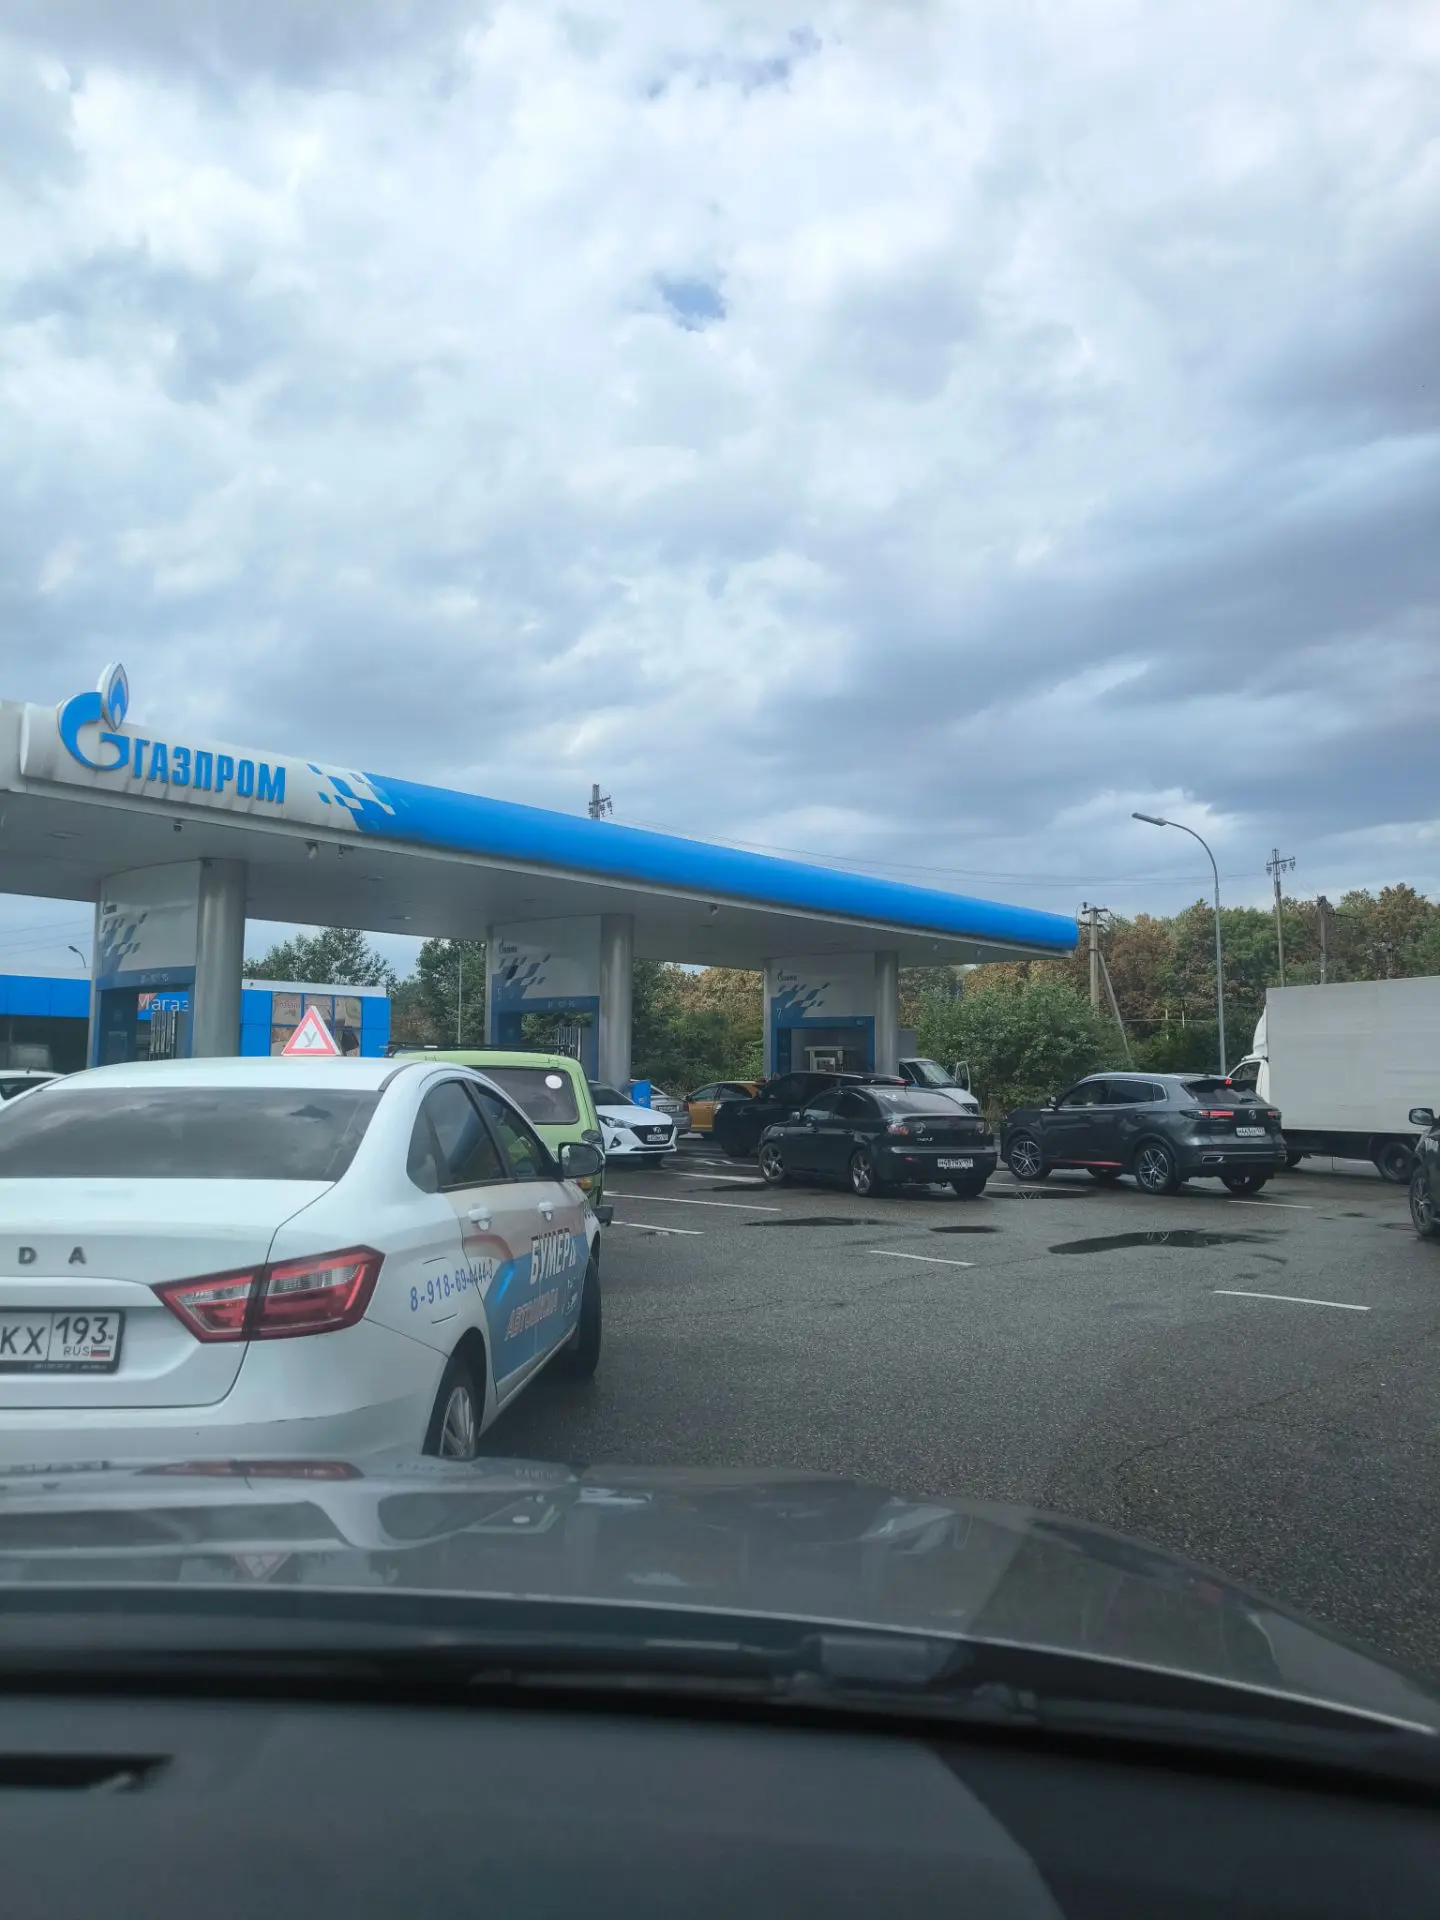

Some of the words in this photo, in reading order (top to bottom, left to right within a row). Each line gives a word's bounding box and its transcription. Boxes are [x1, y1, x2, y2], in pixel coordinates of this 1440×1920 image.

[132, 737, 287, 804] ГАЗПРОМ
[55, 1316, 109, 1345] 193
[63, 1346, 90, 1357] RUS
